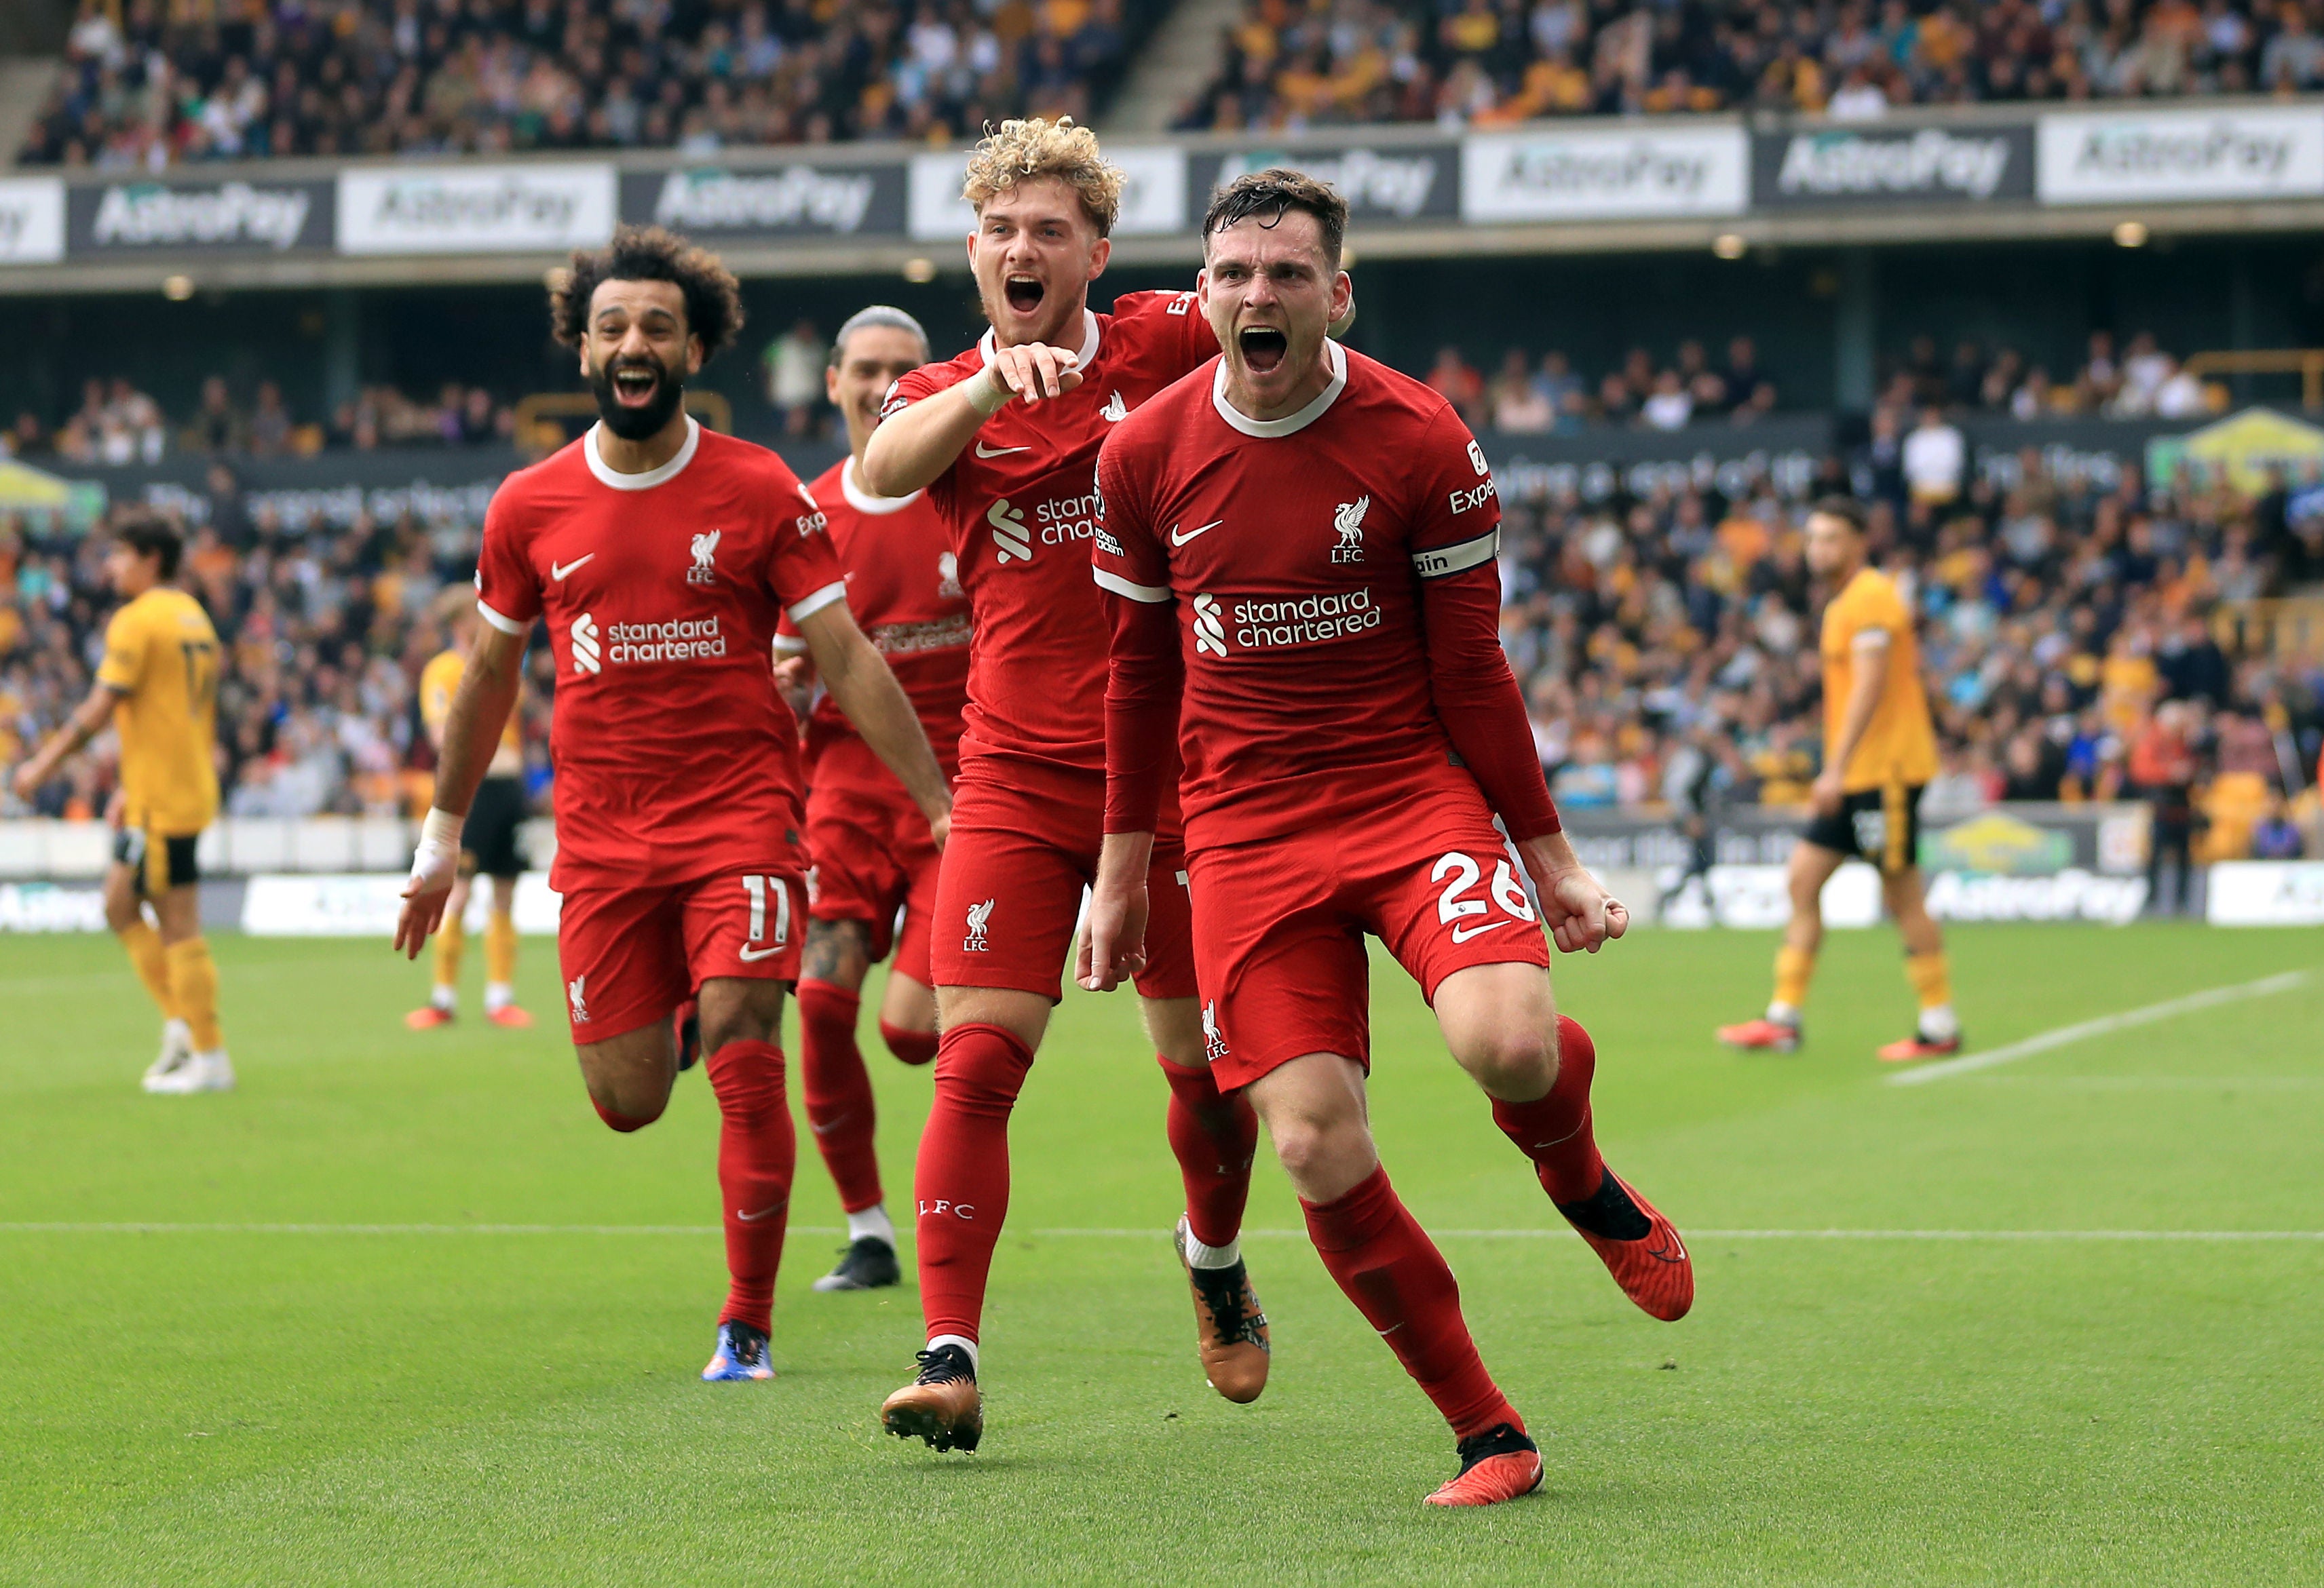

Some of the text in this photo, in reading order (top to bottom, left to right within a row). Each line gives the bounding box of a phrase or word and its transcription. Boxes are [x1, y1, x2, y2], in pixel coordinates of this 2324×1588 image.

[1777, 129, 2010, 200] AstroPay
[93, 180, 311, 252] AstroPay
[655, 164, 875, 233] AstroPay
[1041, 519, 1094, 545] cha
[1234, 586, 1369, 624] standard
[609, 615, 719, 642] standard
[1237, 606, 1381, 648] chartered
[609, 635, 727, 663] chartered
[742, 875, 790, 943] 11
[1431, 852, 1536, 925] 26
[919, 1199, 975, 1220] LFC
